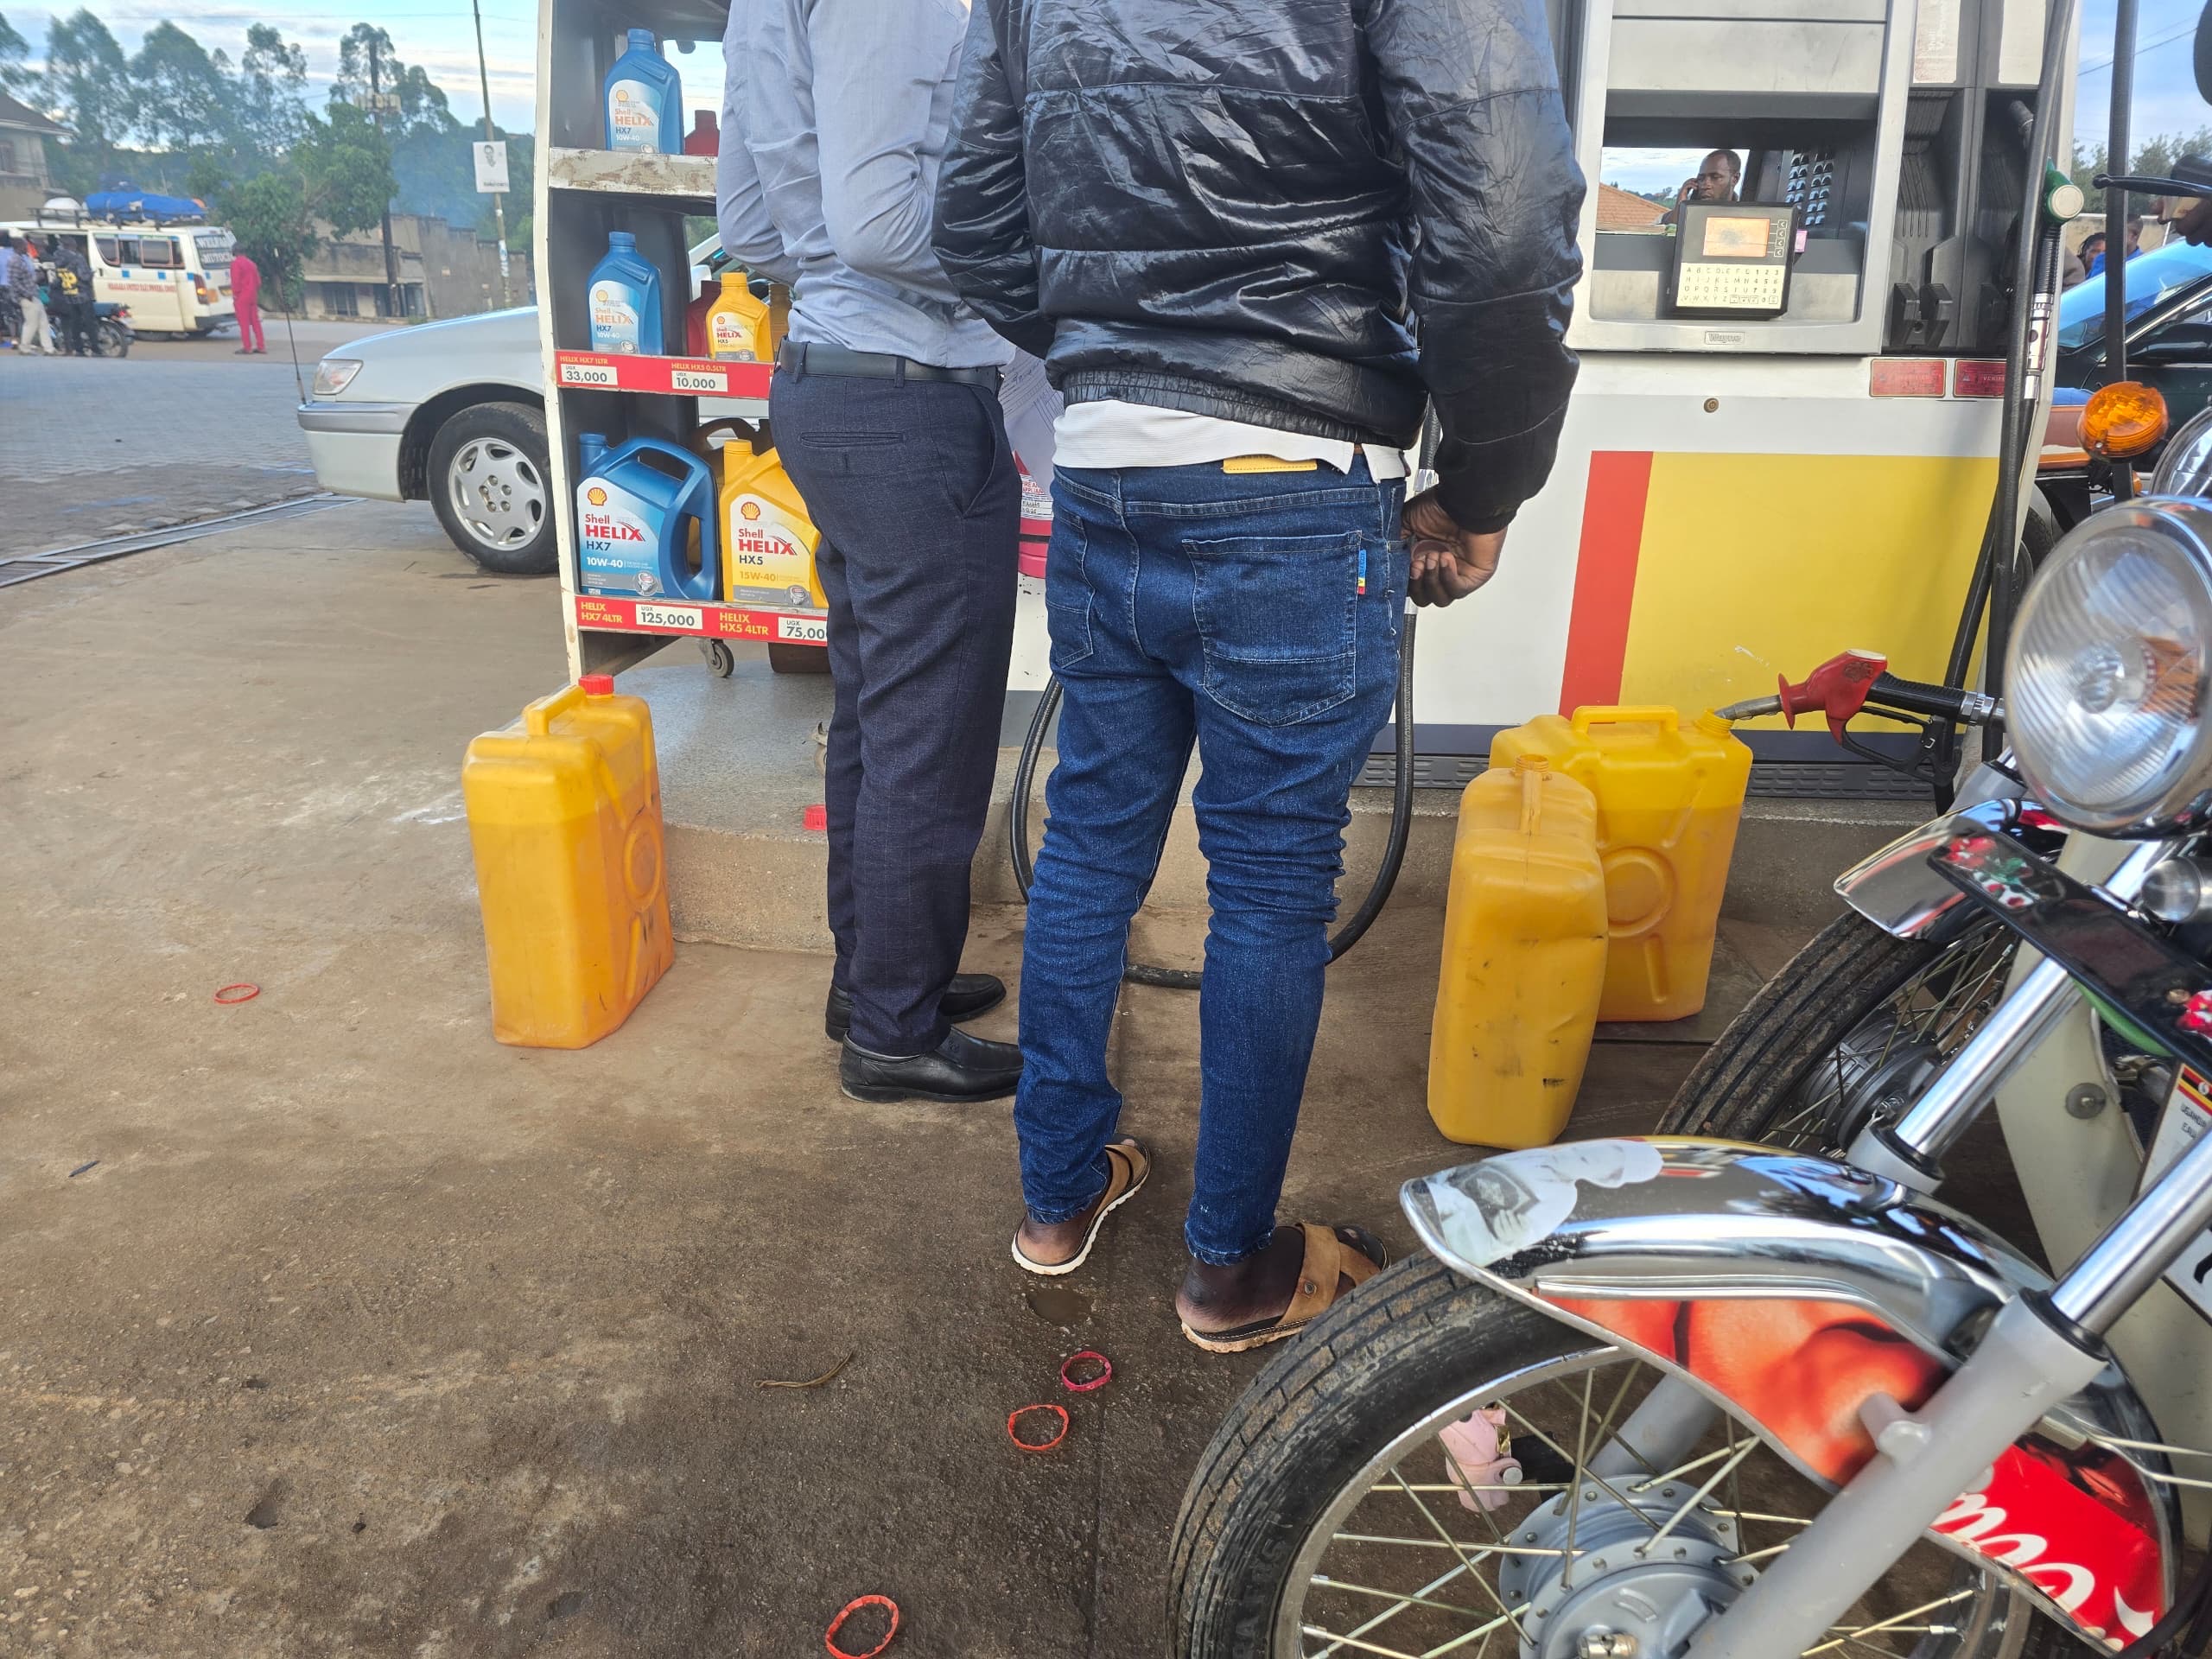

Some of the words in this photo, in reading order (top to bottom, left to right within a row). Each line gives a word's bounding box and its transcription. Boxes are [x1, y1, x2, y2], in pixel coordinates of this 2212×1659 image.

[615, 116, 653, 126] HELIX
[595, 315, 632, 325] HELIX
[566, 371, 607, 382] 33,000
[677, 377, 715, 389] 10,000
[585, 513, 610, 524] Shell
[585, 524, 644, 542] HELIX
[738, 528, 764, 539] Shell
[587, 541, 612, 551] HX7
[738, 538, 796, 556] HELIX
[587, 556, 624, 569] 10W-40
[739, 555, 764, 565] HX5
[740, 570, 776, 582] 15W-40
[581, 601, 606, 612] HELIX
[581, 612, 601, 621] HX7
[601, 613, 622, 623] 4LTR
[641, 612, 695, 626] 125,000
[719, 612, 750, 623] HELIX
[720, 622, 742, 633] HX5
[745, 624, 769, 636] 4LTR
[786, 626, 825, 640] 75,00
